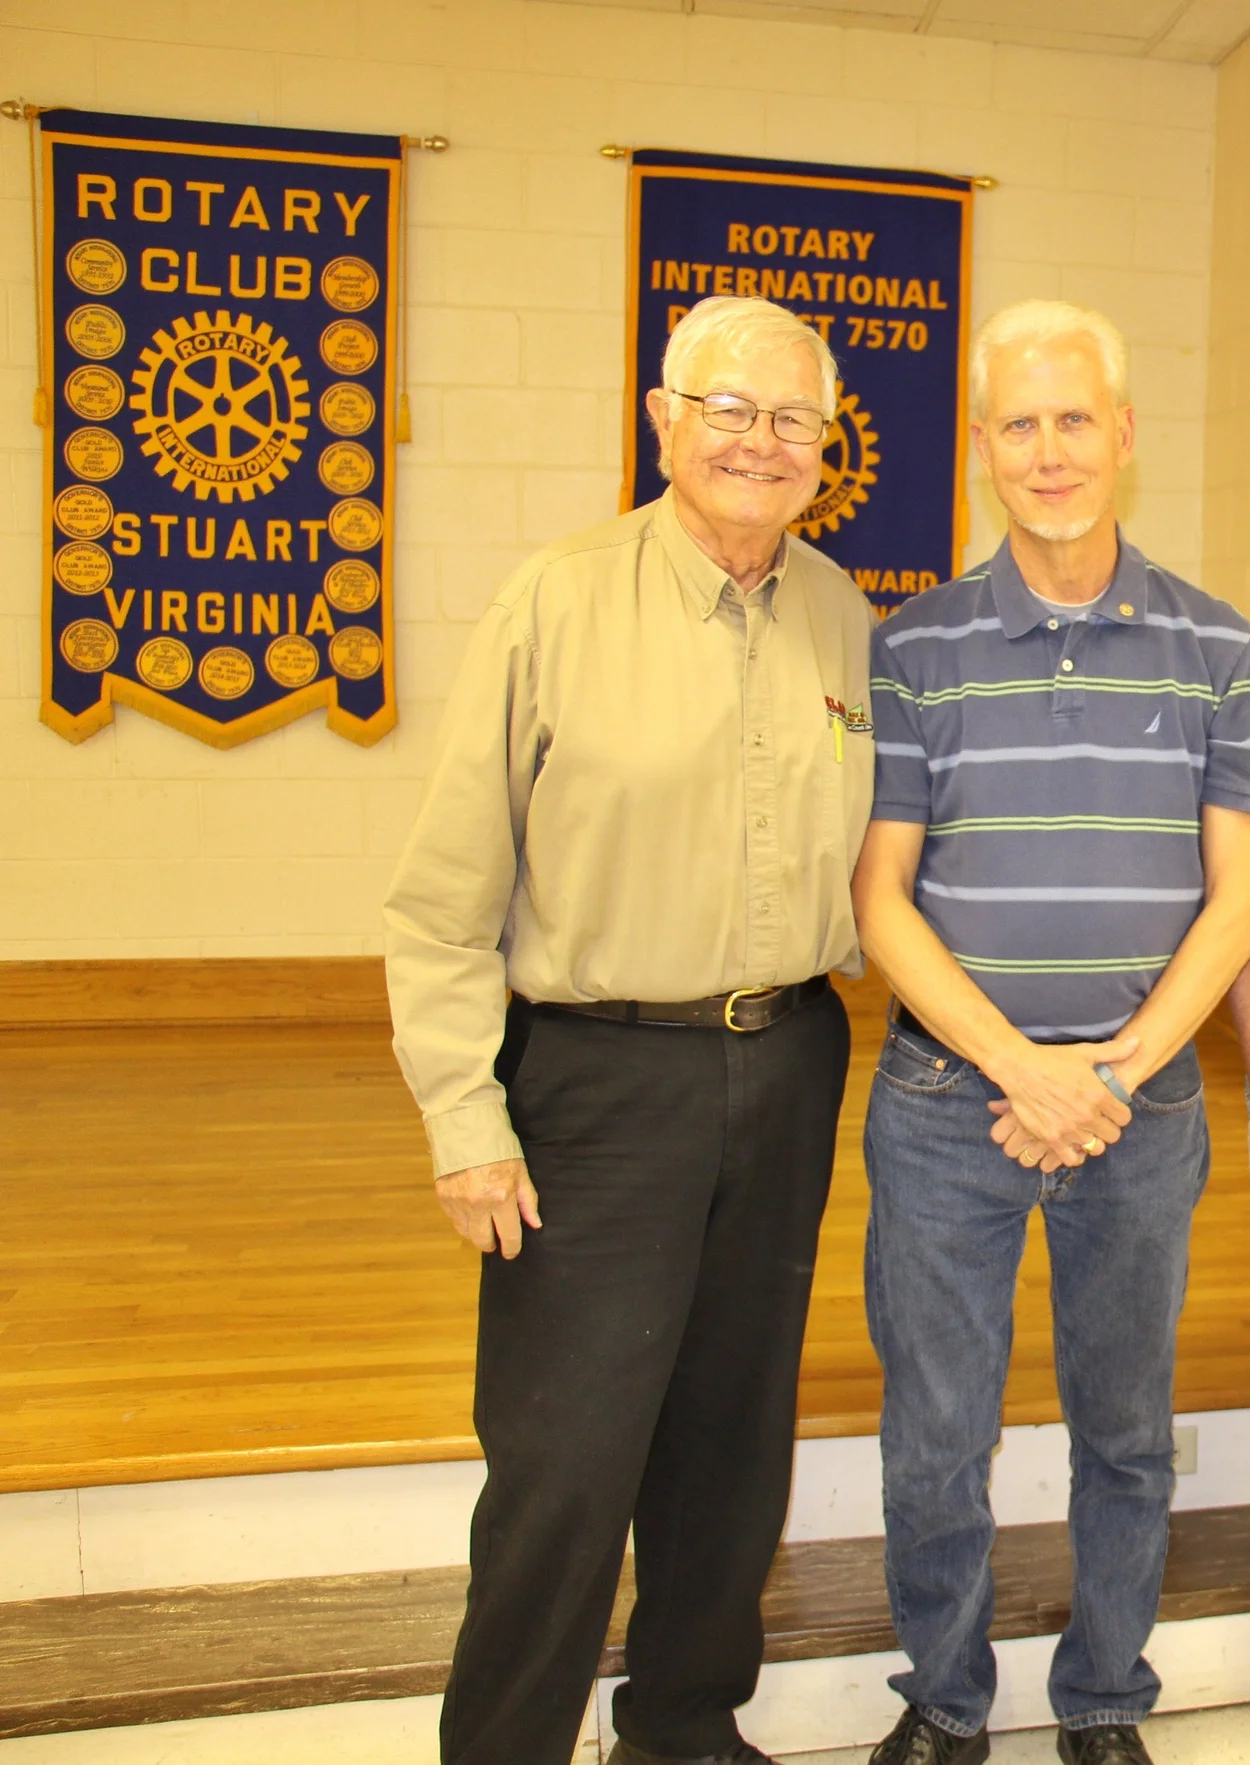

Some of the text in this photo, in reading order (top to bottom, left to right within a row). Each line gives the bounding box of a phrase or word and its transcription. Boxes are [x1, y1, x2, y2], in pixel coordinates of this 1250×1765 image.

[77, 173, 371, 237] ROTARY
[728, 222, 875, 262] ROTARY
[140, 247, 312, 300] CLUB
[651, 260, 948, 310] INTERNATIONAL
[177, 332, 269, 363] ROTARY
[846, 315, 929, 351] 7570
[158, 425, 286, 482] INTERNATIONAL
[112, 512, 328, 564] STUART
[842, 568, 938, 594] WARD
[104, 587, 336, 637] VIRGINIA
